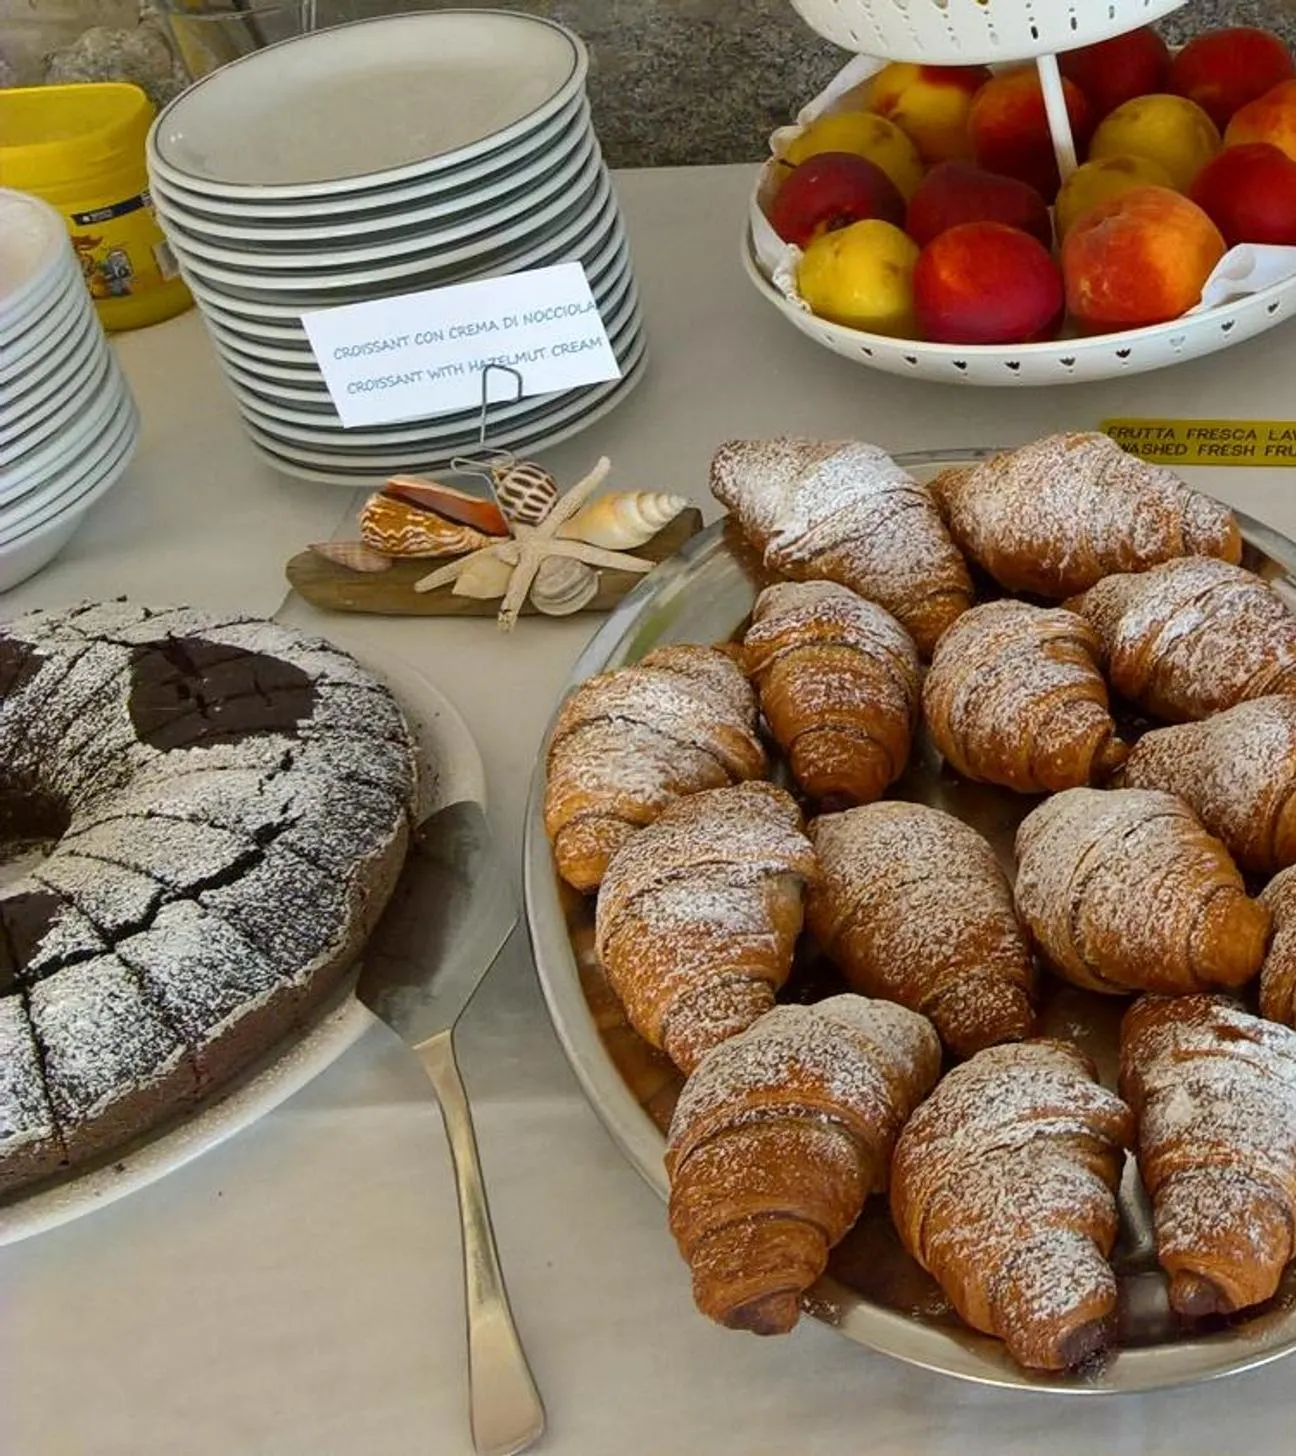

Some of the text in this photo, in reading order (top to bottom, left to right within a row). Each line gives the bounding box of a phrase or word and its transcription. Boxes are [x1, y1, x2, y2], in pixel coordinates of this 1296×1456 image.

[333, 301, 596, 360] CROISSANT CON CREMA DI NOCCIOLA
[347, 370, 424, 395] CROISSANT
[427, 362, 464, 381] WITH
[551, 336, 603, 358] CREAM
[1107, 425, 1176, 440] FRUTTA
[1186, 427, 1257, 441] FRESCA
[1197, 443, 1256, 457] FRESH
